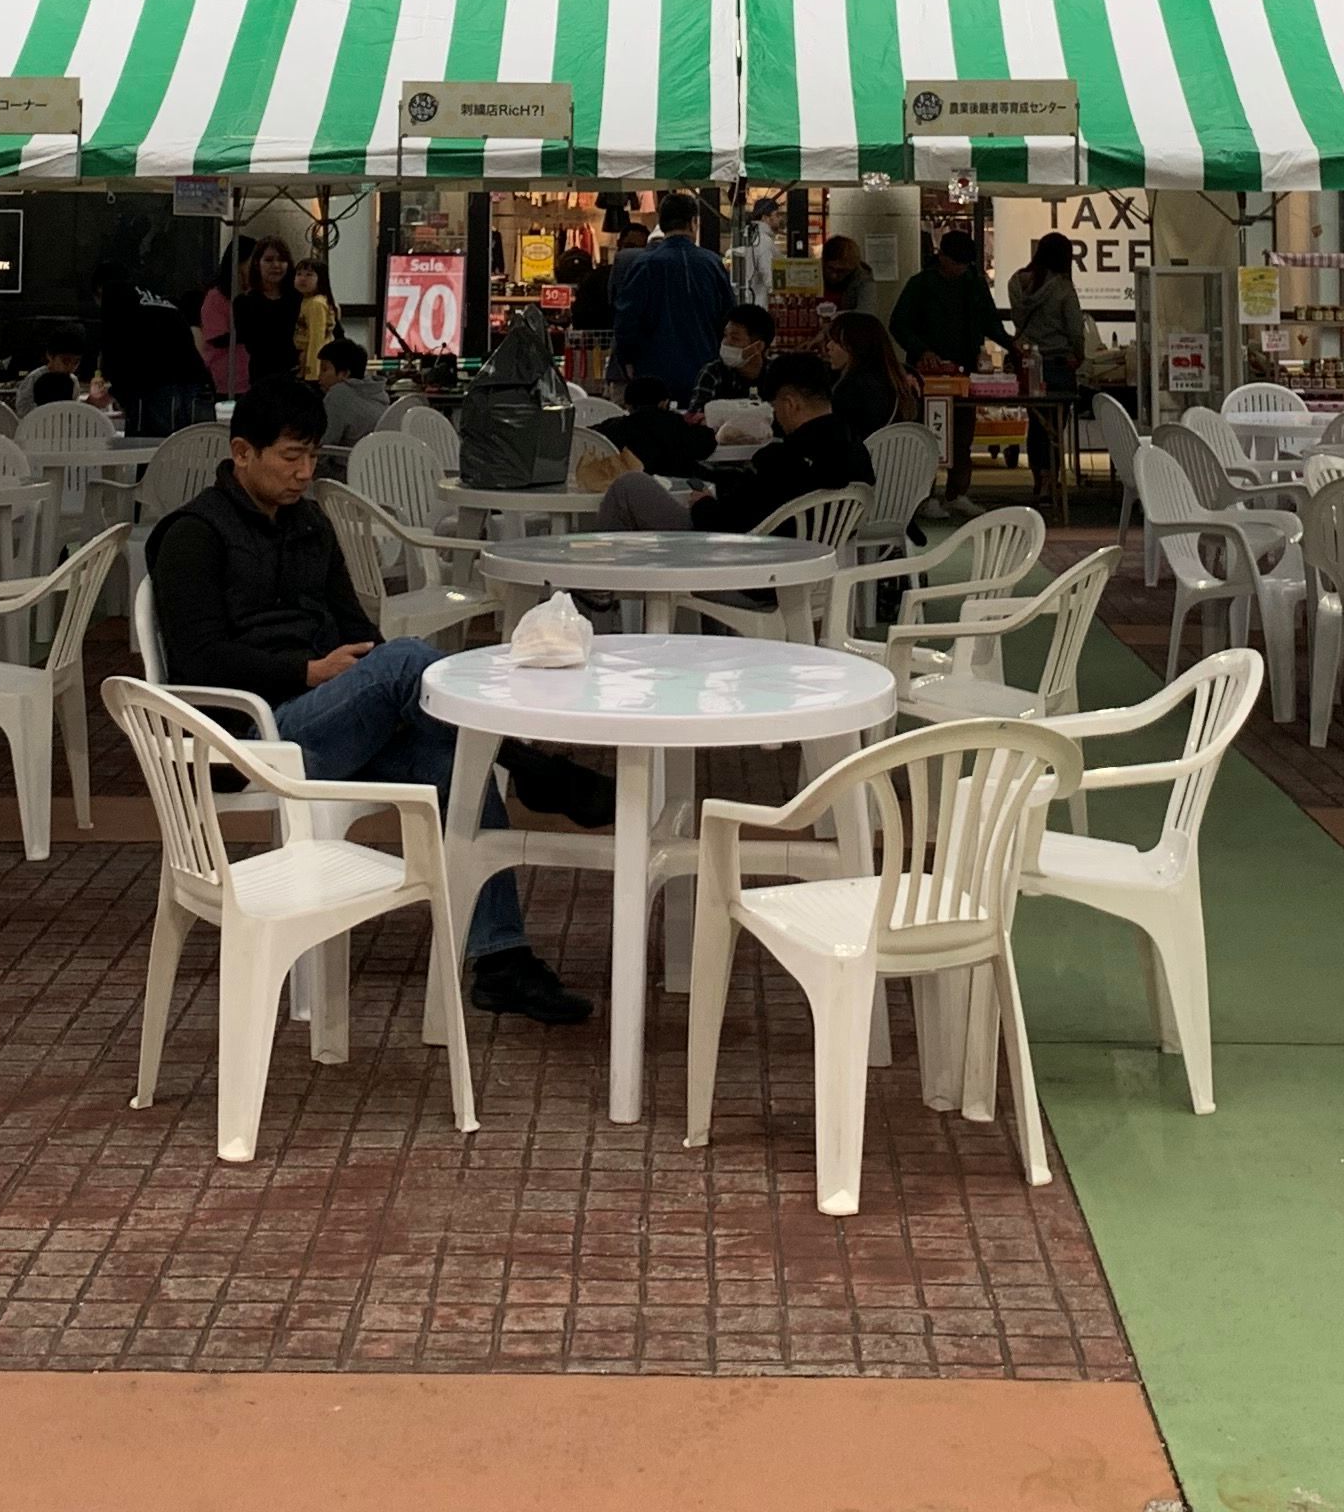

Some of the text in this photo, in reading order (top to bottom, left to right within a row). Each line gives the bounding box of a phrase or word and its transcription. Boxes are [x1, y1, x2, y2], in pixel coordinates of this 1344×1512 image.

[948, 101, 1067, 115] 農業後継者等育成センター
[1041, 196, 1137, 230] TAX
[410, 258, 445, 272] Sale
[387, 284, 457, 350] 70
